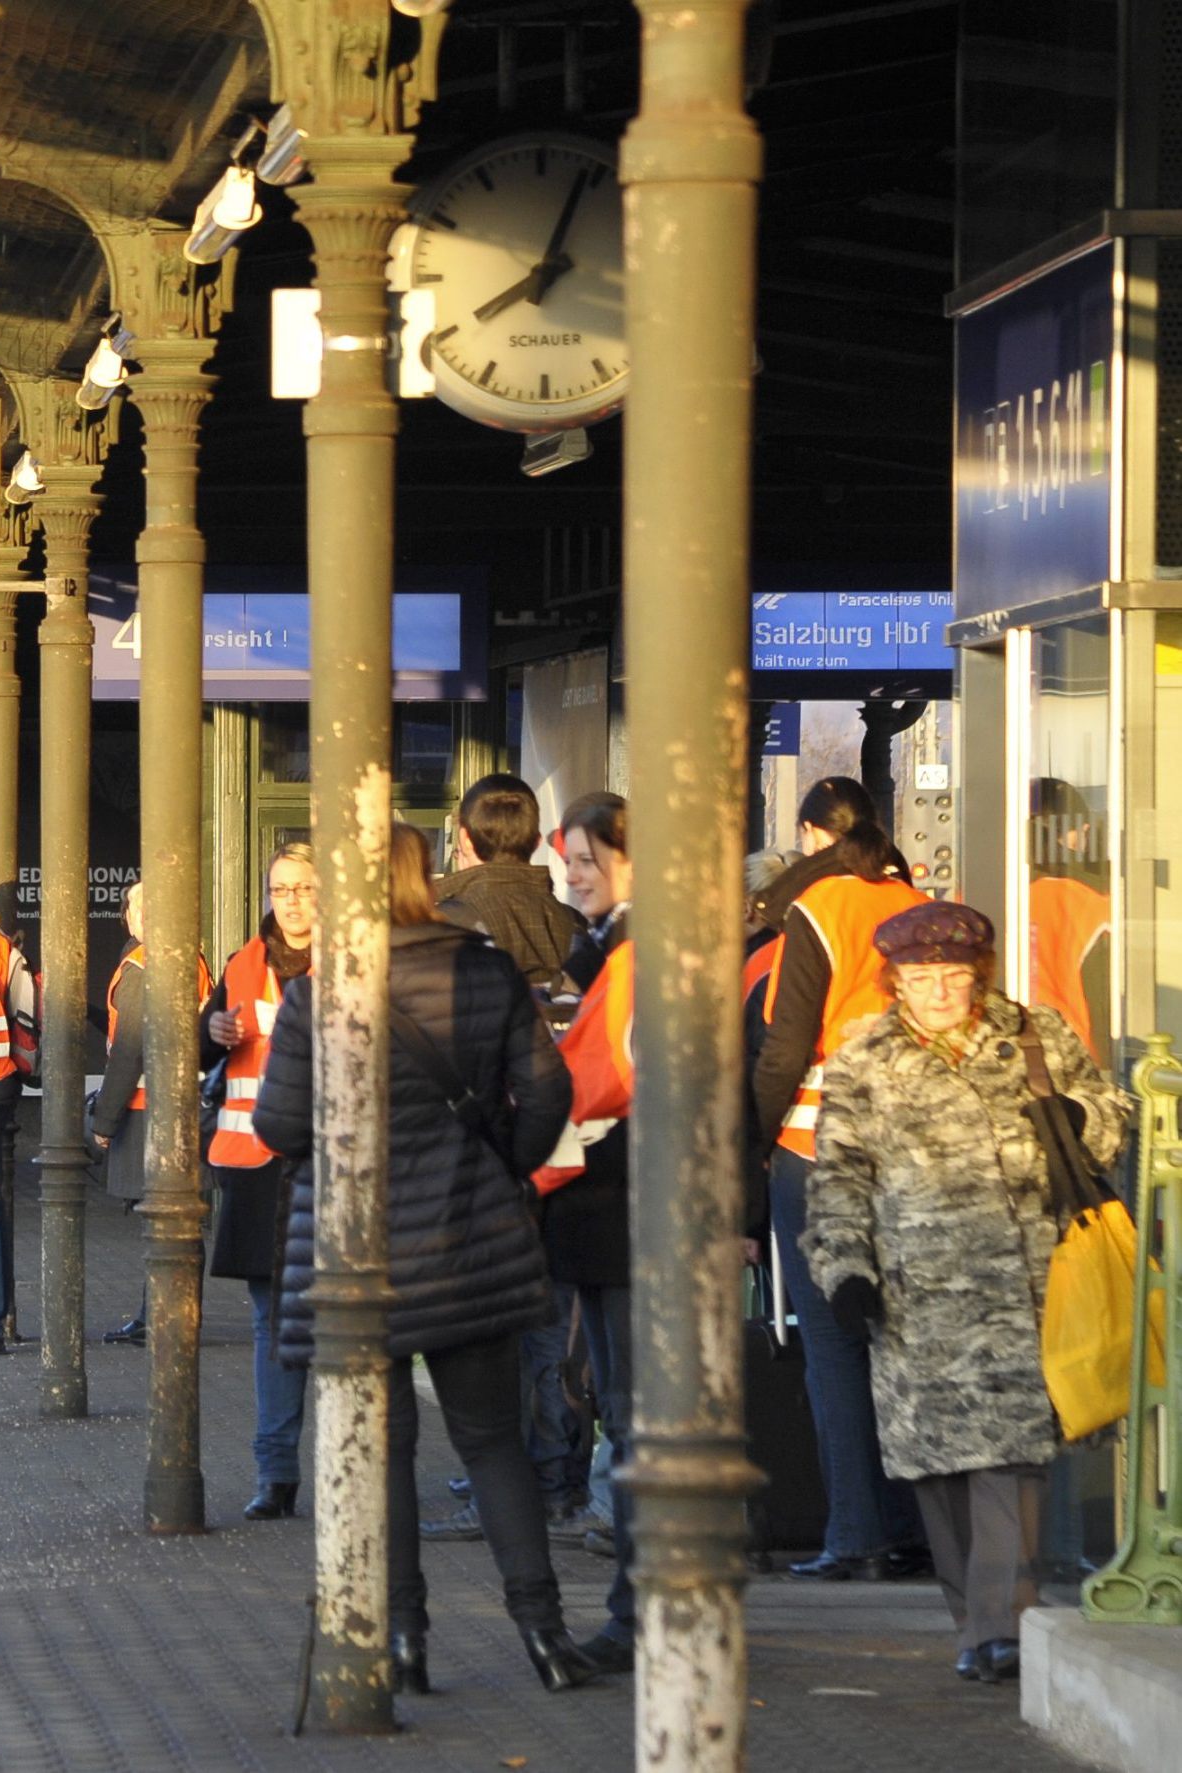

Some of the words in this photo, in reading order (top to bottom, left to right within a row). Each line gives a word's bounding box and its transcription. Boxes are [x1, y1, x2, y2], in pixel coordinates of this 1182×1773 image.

[509, 333, 582, 348] SCHAUER
[839, 593, 922, 606] Paracelsus
[111, 611, 142, 659] 4
[755, 622, 872, 648] Salzburg
[884, 621, 931, 645] Hbf
[755, 654, 784, 667] hält
[787, 656, 813, 667] nur
[816, 656, 848, 667] zum
